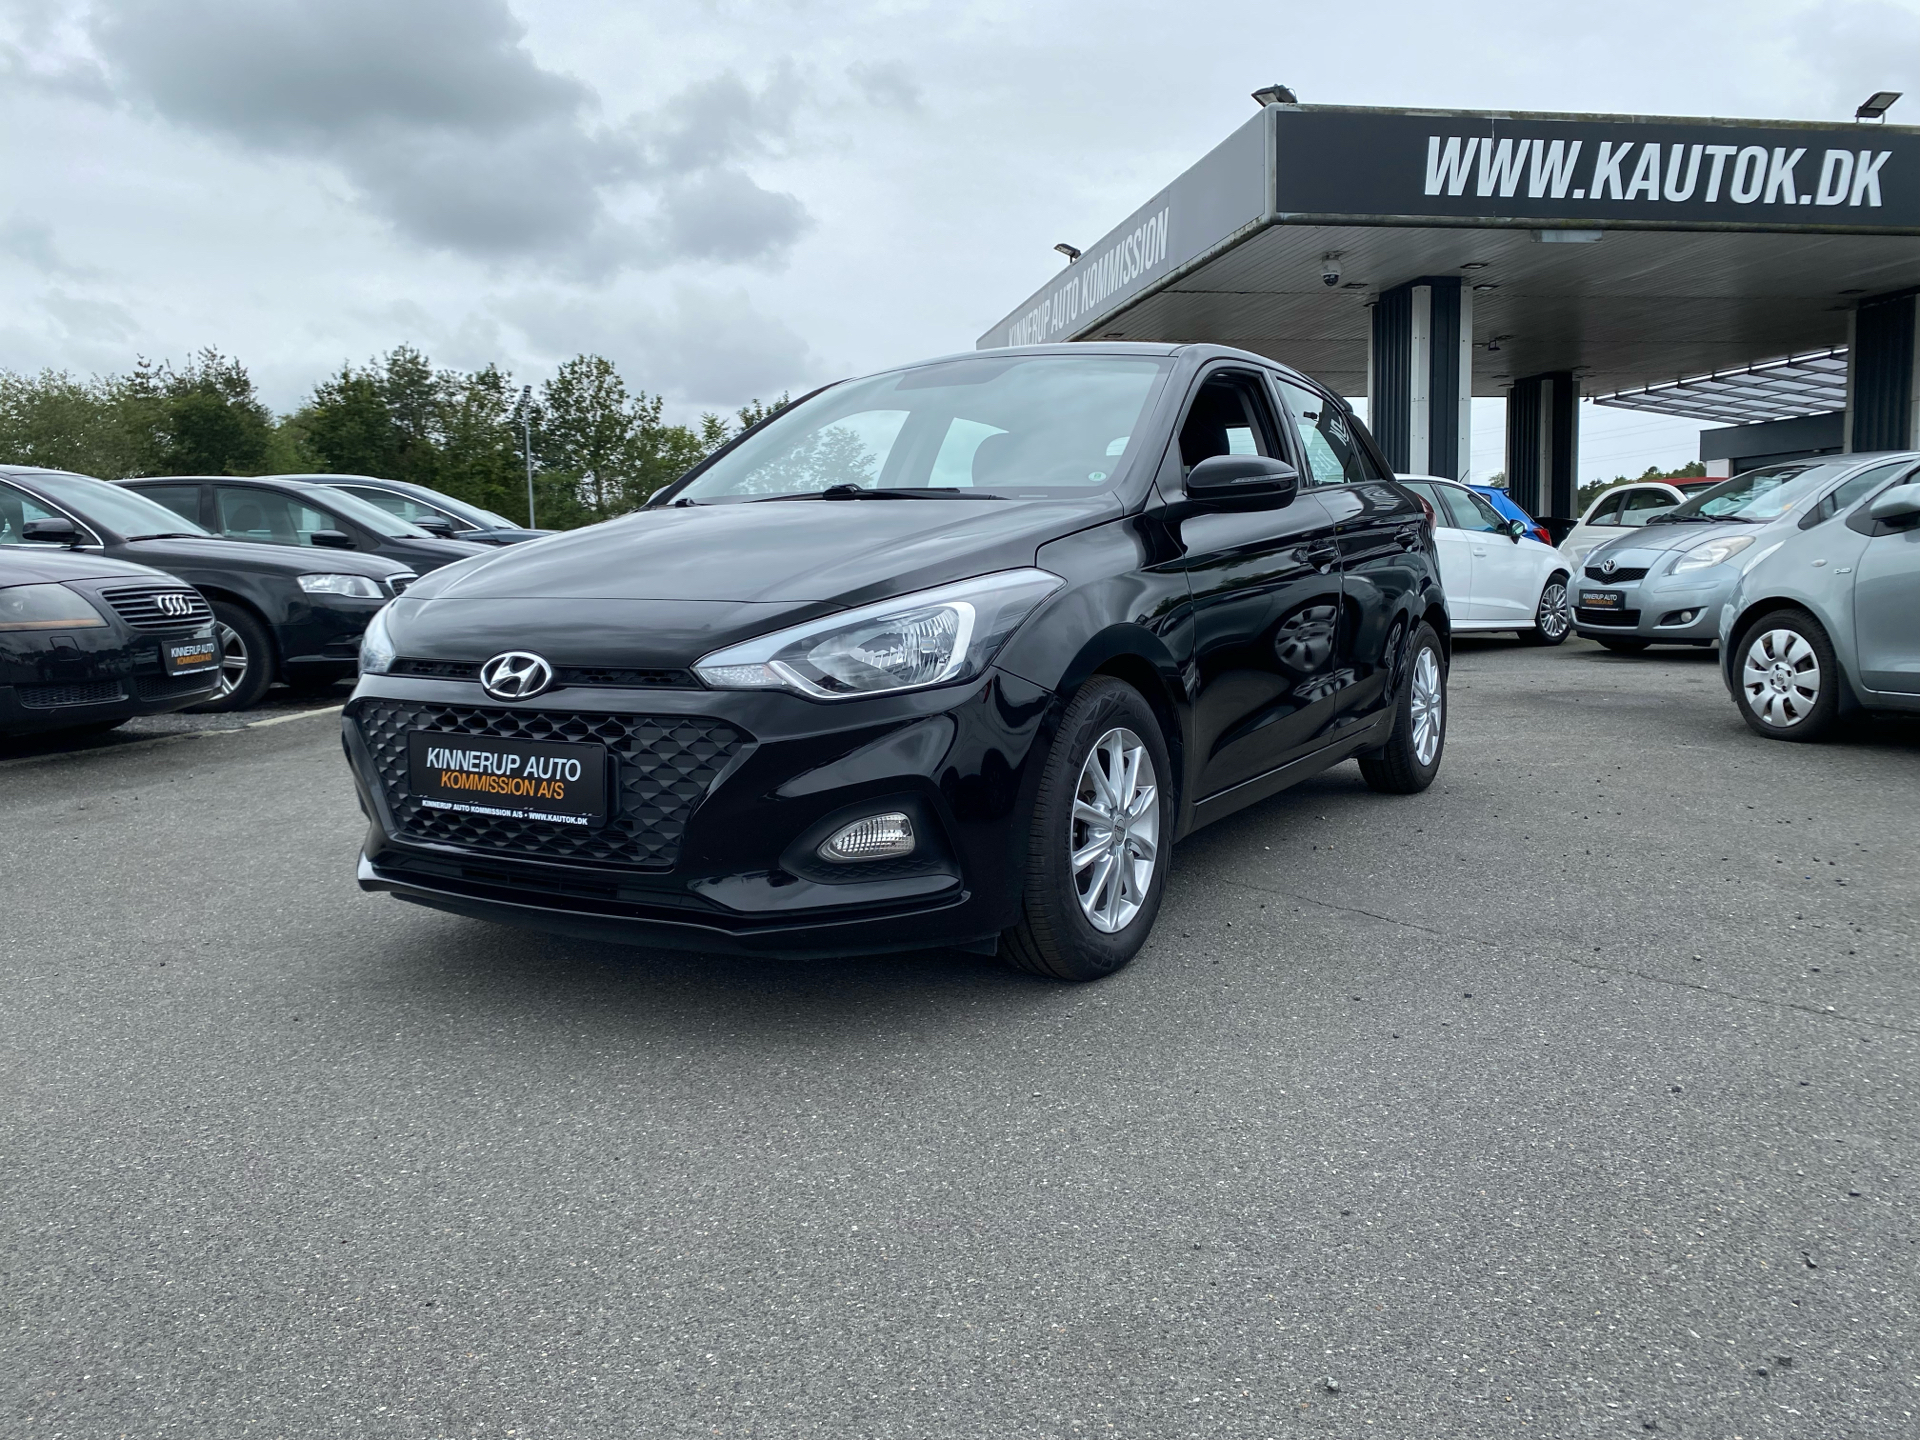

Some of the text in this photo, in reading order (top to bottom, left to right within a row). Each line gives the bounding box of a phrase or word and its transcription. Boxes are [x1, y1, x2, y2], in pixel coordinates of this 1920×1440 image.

[1424, 136, 1893, 207] WWW.KAUTOK.DK
[1051, 276, 1079, 334] AUTO
[1081, 207, 1169, 314] KOMMISSION
[426, 747, 582, 782] KINNERUP AUTO
[441, 771, 565, 800] KOMMISSION A/S
[422, 799, 588, 826] KINNERUP AUTO KOMMISSION A/S WWW.KAUTOK.DK
